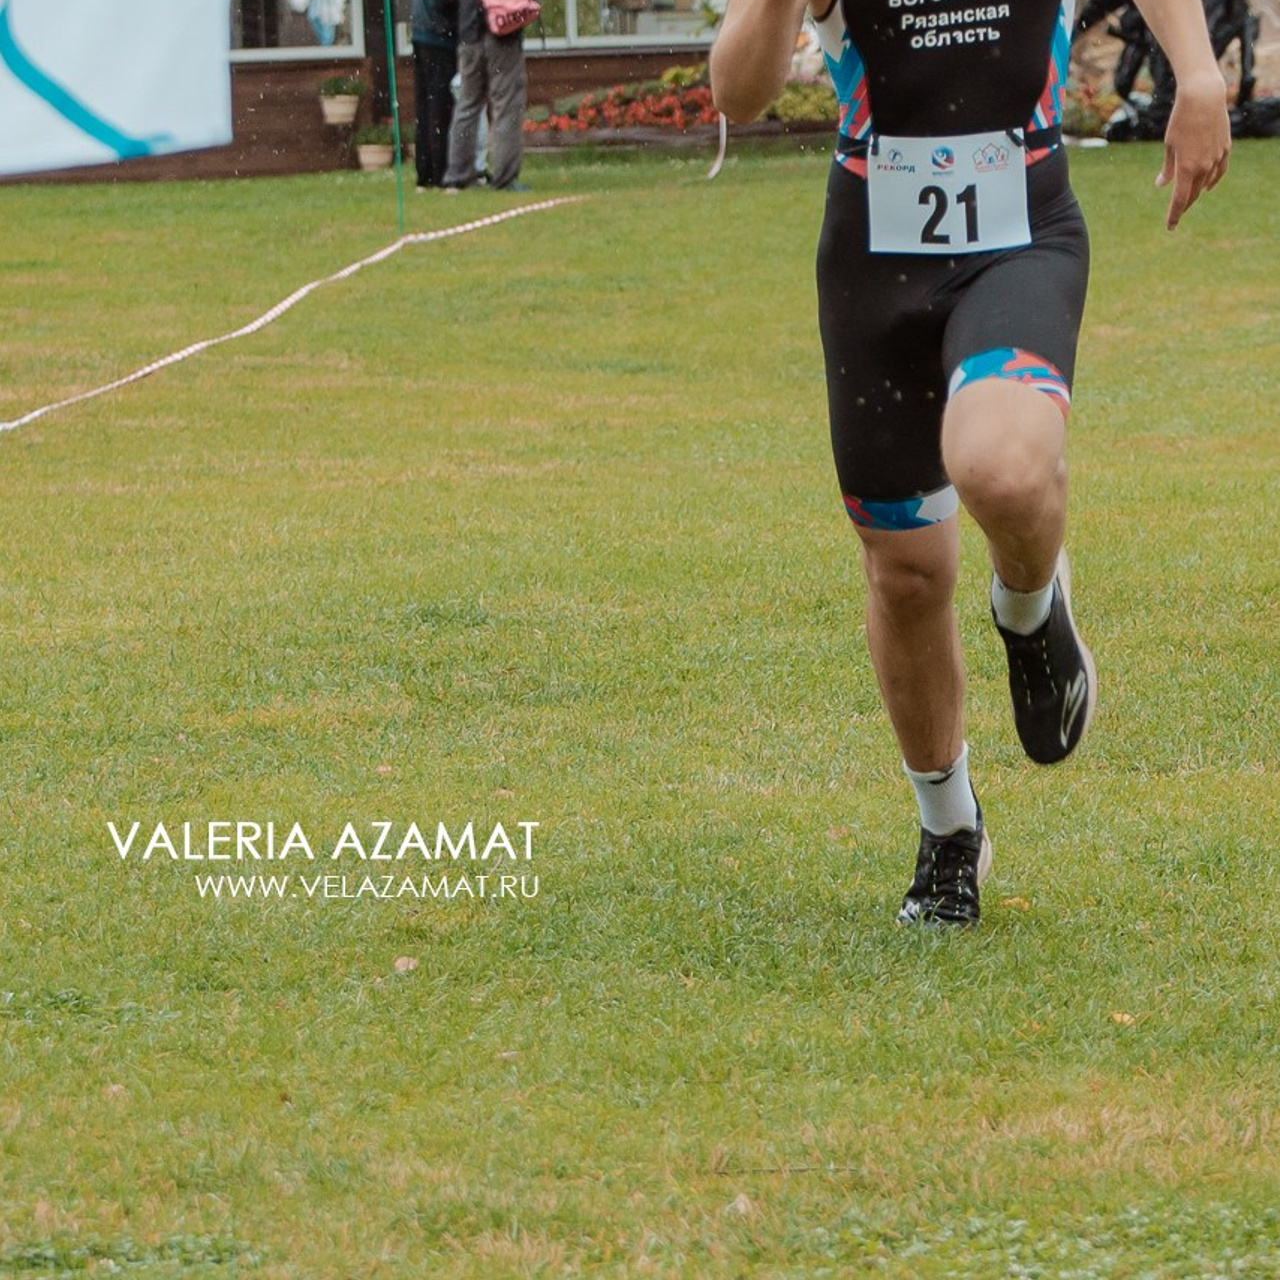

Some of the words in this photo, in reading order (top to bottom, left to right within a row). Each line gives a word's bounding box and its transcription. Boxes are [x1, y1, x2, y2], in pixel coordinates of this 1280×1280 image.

[901, 4, 1010, 30] Рязанская
[911, 26, 1001, 48] область
[918, 183, 979, 245] 21
